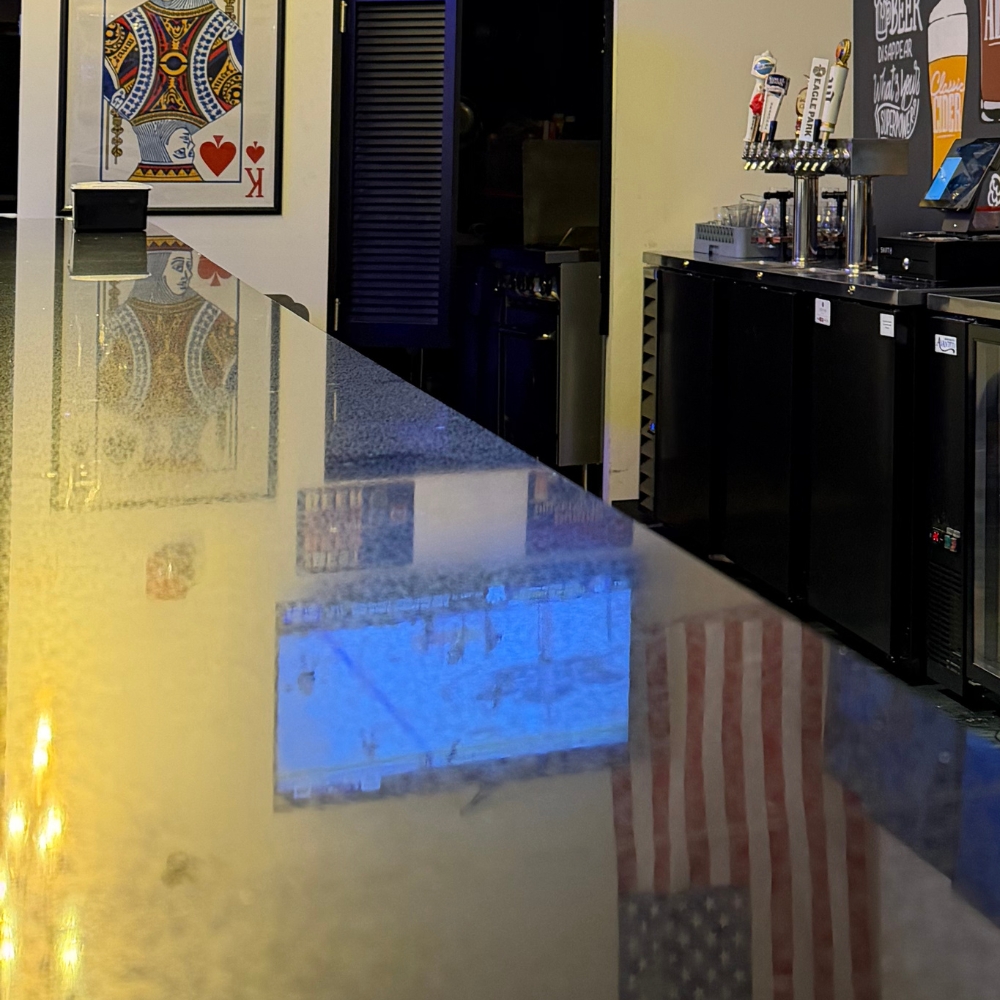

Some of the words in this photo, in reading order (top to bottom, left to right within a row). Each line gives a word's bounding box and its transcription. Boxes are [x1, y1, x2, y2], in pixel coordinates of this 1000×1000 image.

[877, 38, 913, 63] DISAPPEAR
[809, 78, 821, 109] EAGLE
[873, 65, 899, 104] What's
[900, 60, 920, 111] your
[930, 71, 964, 96] Classic
[804, 111, 816, 137] PARK
[933, 92, 962, 133] CIDER
[245, 167, 264, 198] K
